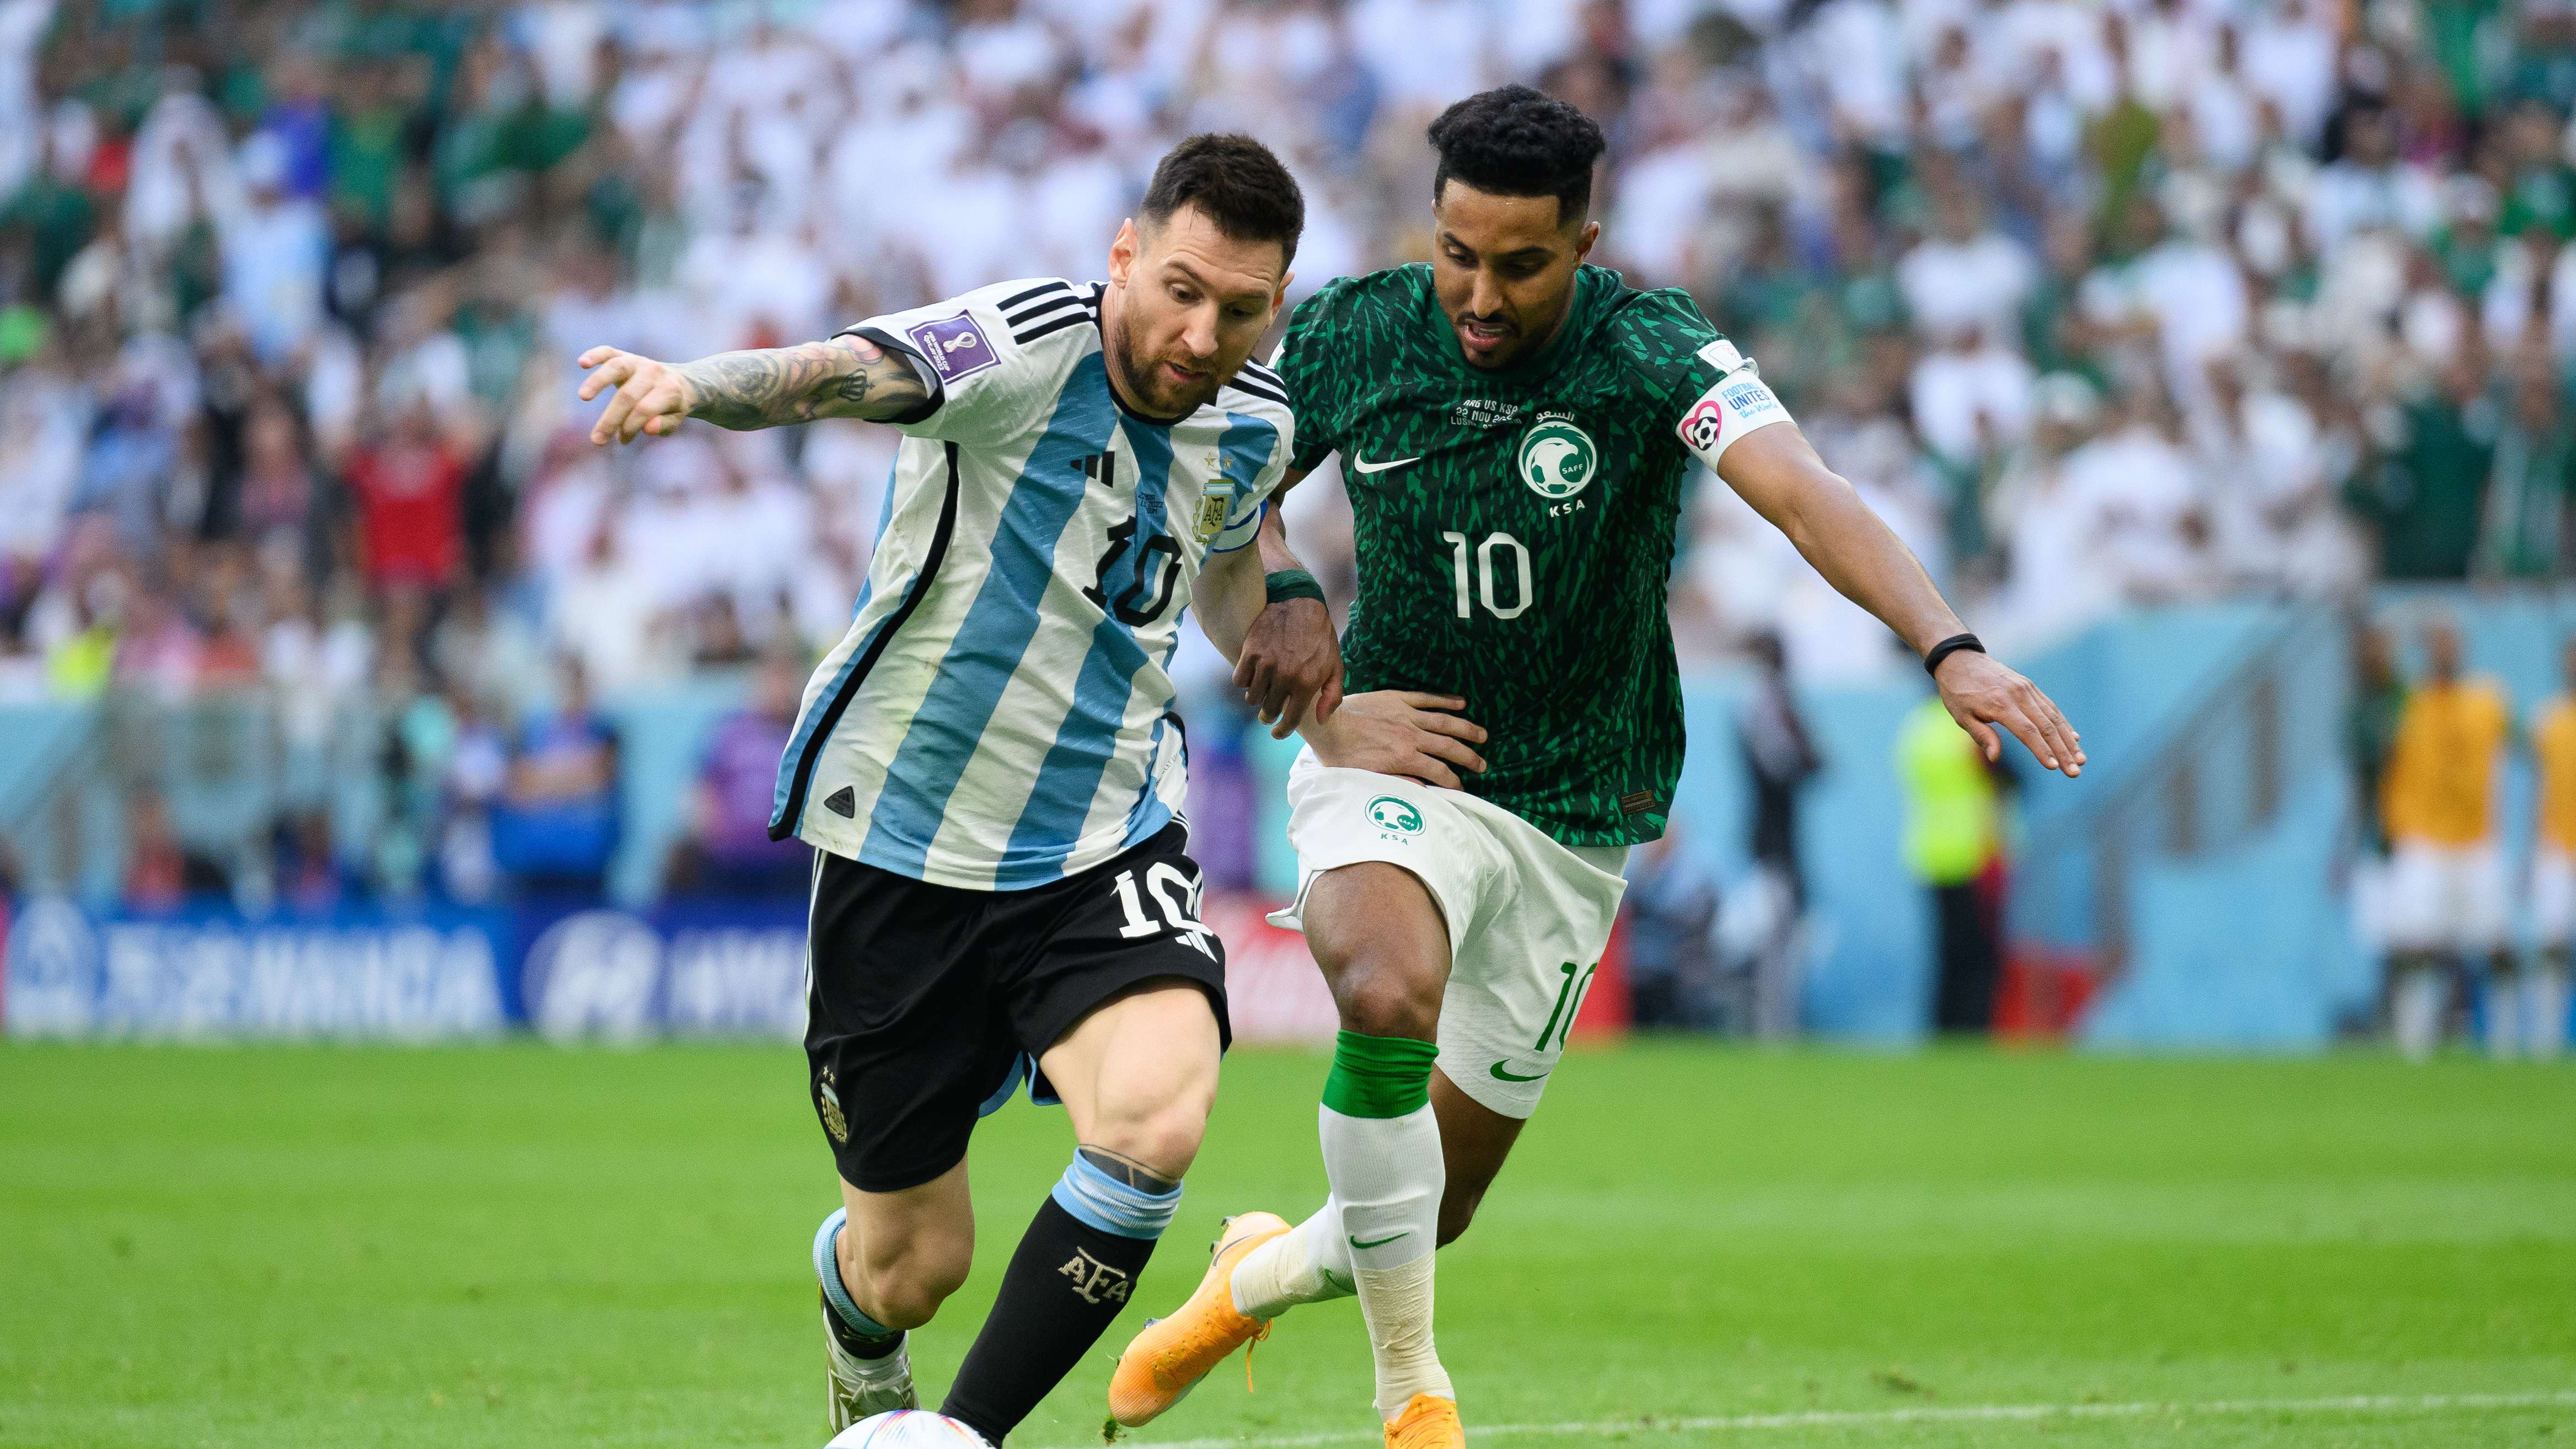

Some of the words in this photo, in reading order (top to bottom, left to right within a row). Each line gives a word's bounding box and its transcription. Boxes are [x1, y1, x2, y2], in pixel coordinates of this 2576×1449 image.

[1463, 399, 1482, 408] ARG
[1728, 390, 1770, 410] UNITES
[1456, 407, 1468, 418] 22
[1738, 410, 1756, 418] the
[1561, 464, 1584, 474] SAFF
[1203, 496, 1225, 527] AFA
[1549, 500, 1585, 517] KSA
[1081, 514, 1182, 628] 10
[1443, 532, 1532, 619] 10
[1381, 833, 1408, 845] KSA
[1110, 862, 1213, 938] 10
[1058, 1246, 1129, 1303] AFA
